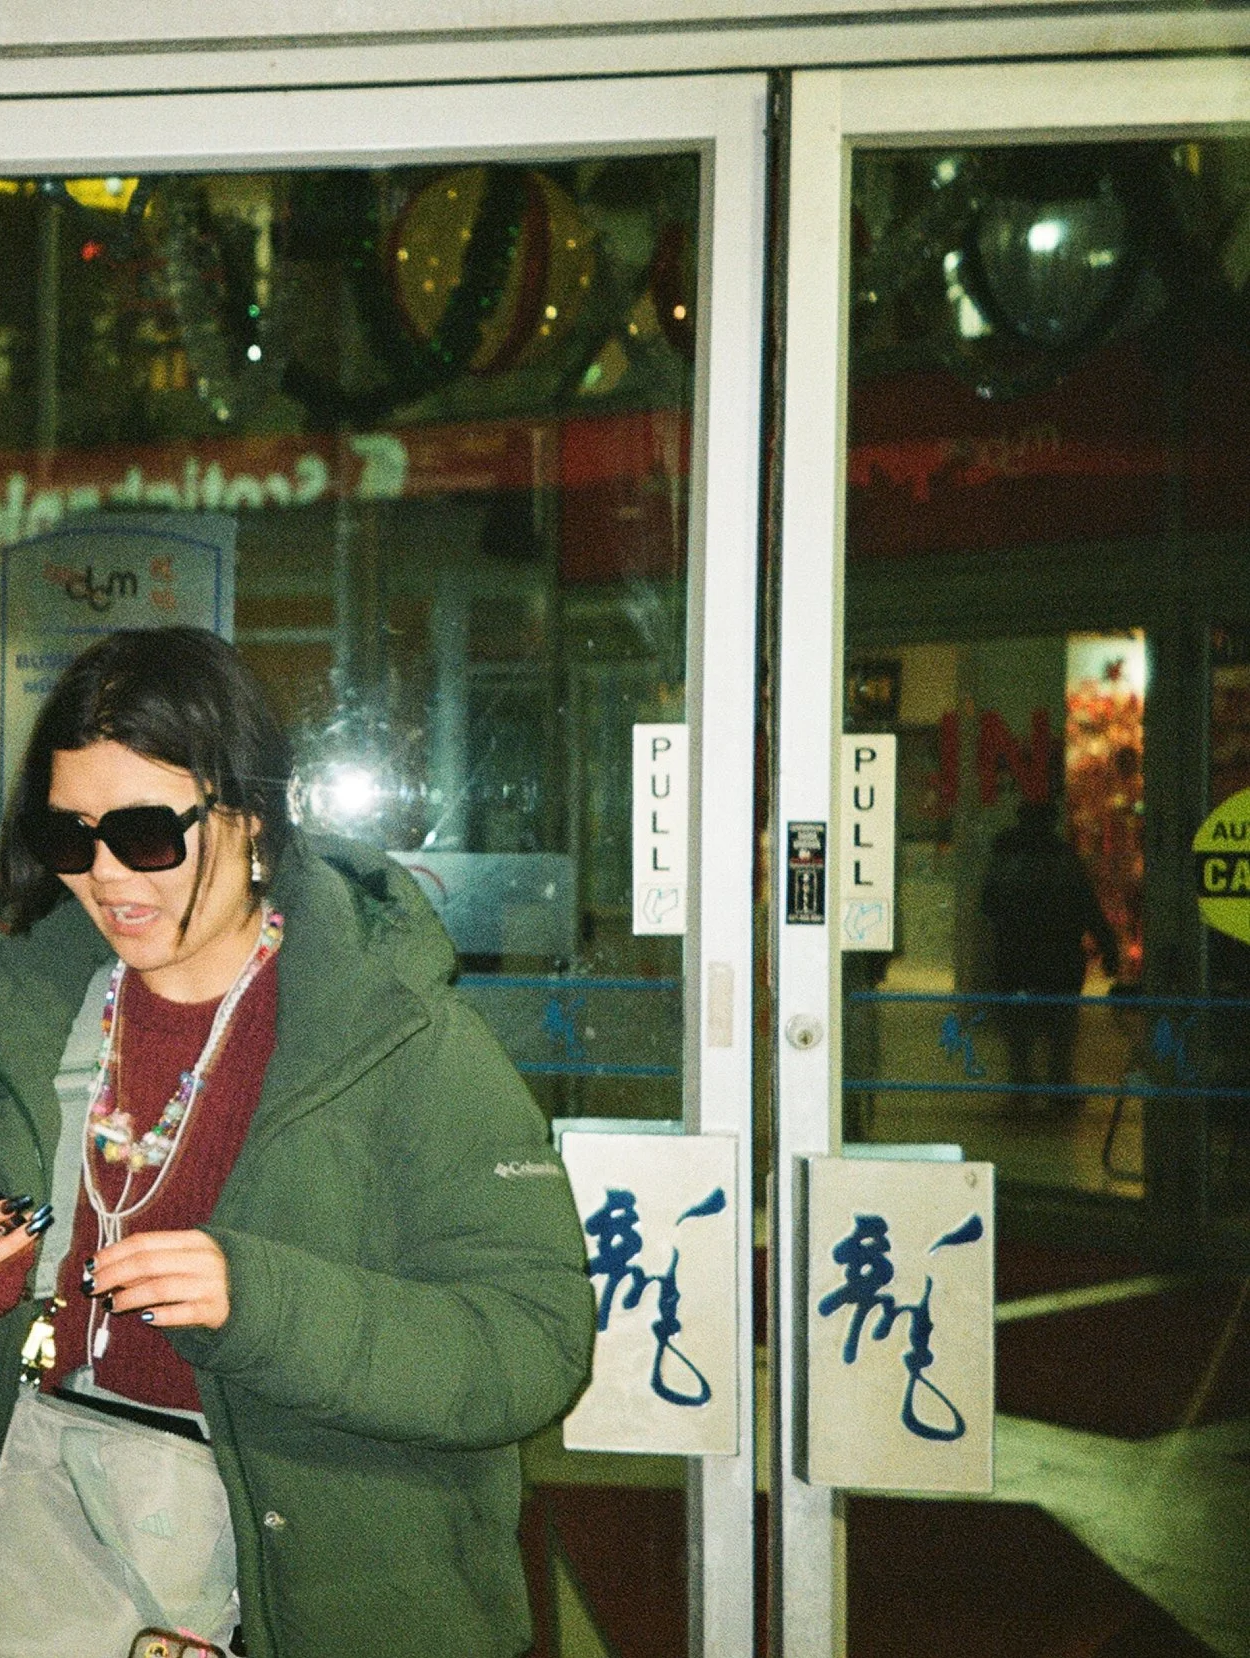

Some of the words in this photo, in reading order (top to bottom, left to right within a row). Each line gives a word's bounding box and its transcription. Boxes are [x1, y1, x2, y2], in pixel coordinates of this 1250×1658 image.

[651, 736, 672, 872] PULL
[853, 746, 877, 886] PULL
[1212, 821, 1250, 840] AU
